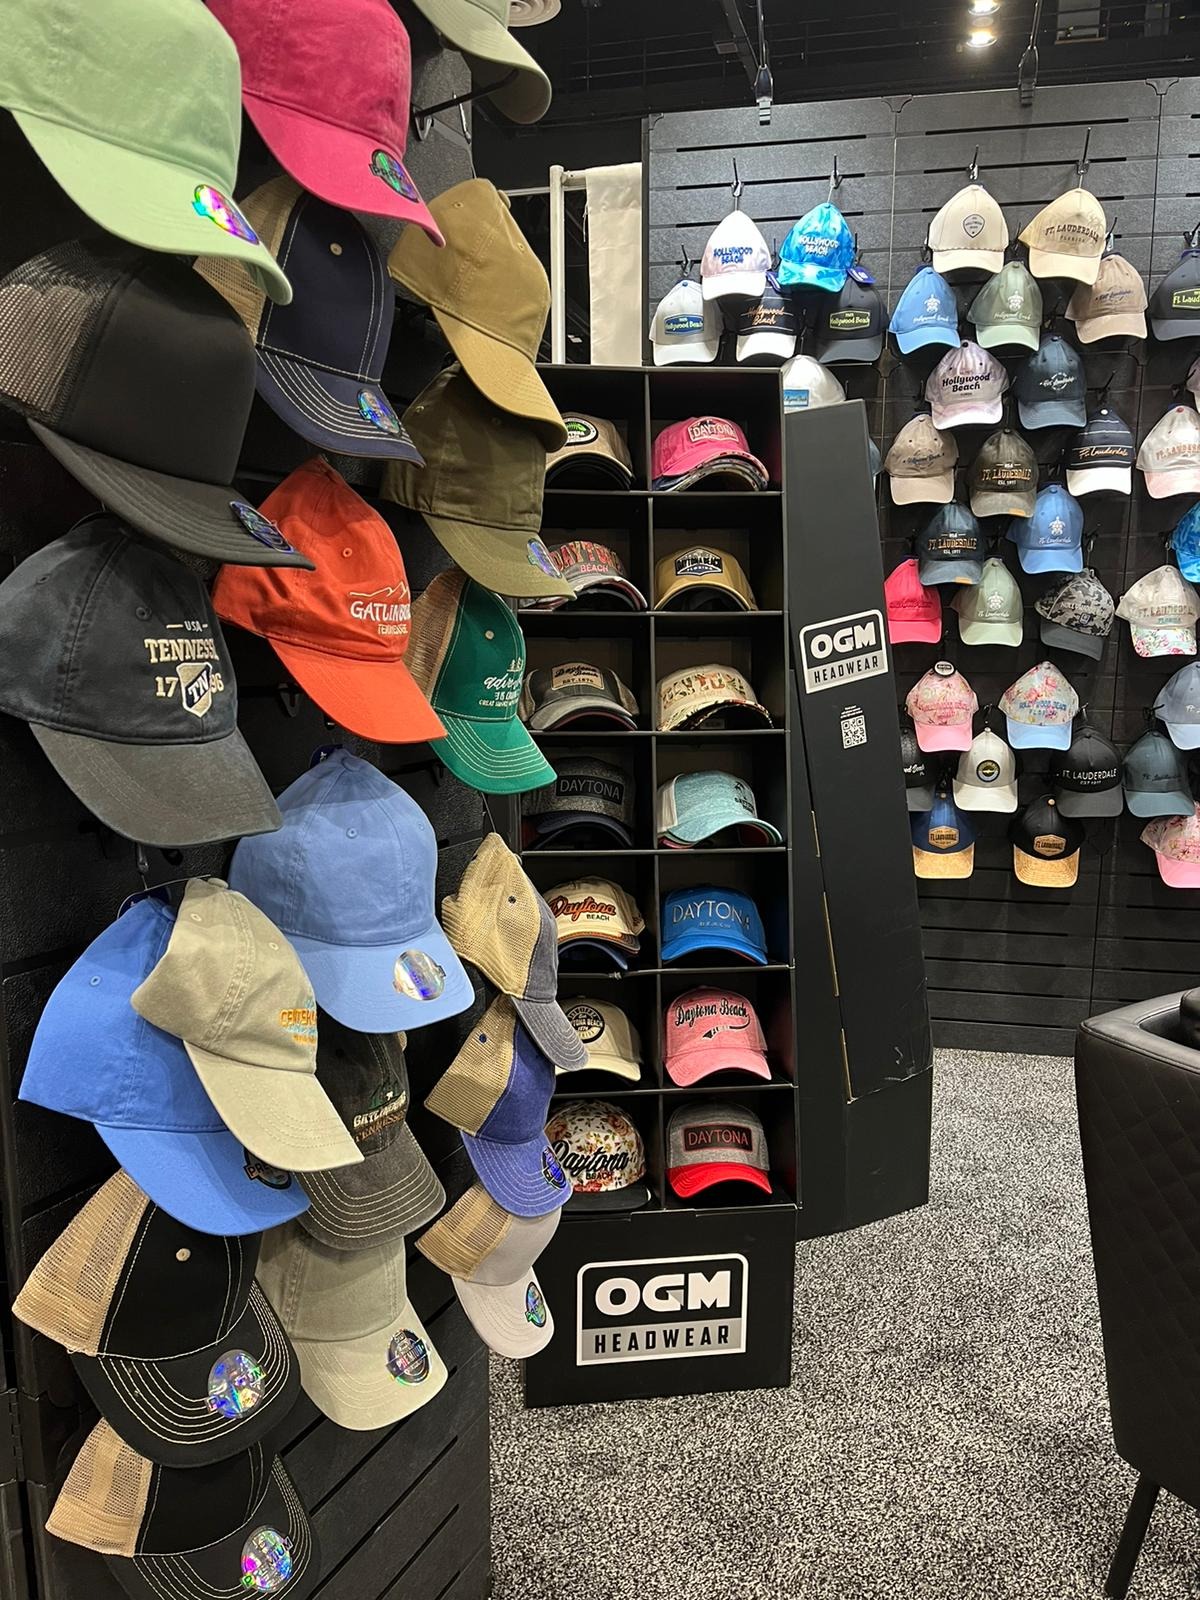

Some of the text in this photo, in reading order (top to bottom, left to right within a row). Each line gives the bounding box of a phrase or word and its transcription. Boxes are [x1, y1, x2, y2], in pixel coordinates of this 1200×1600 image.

[799, 234, 840, 248] HOLLYWOOD
[1056, 223, 1100, 243] LAUDERDALE
[713, 246, 753, 257] HOLLYWOOD
[805, 243, 829, 257] BEACH
[942, 372, 991, 388] Hollywood
[952, 381, 981, 393] Beach
[992, 468, 1032, 481] LAUDERDALE
[937, 538, 977, 550] LAUDERDALE
[580, 563, 609, 573] BEACH
[184, 620, 203, 632] USA
[810, 621, 877, 659] OGM
[814, 655, 879, 683] HEADWEAR
[187, 669, 210, 703] TN
[1072, 768, 1118, 781] LAUDERDALE
[559, 779, 621, 801] DAYTONA
[548, 894, 617, 921] Daytona
[673, 900, 750, 931] DAYTONA
[586, 913, 610, 921] BEACH
[674, 997, 748, 1028] Daytona Beach
[688, 1129, 749, 1147] DAYTONA
[551, 1139, 631, 1178] Daytona
[586, 1170, 614, 1181] BEACH
[594, 1269, 731, 1317] OGM
[594, 1324, 730, 1355] HEADWEAR
